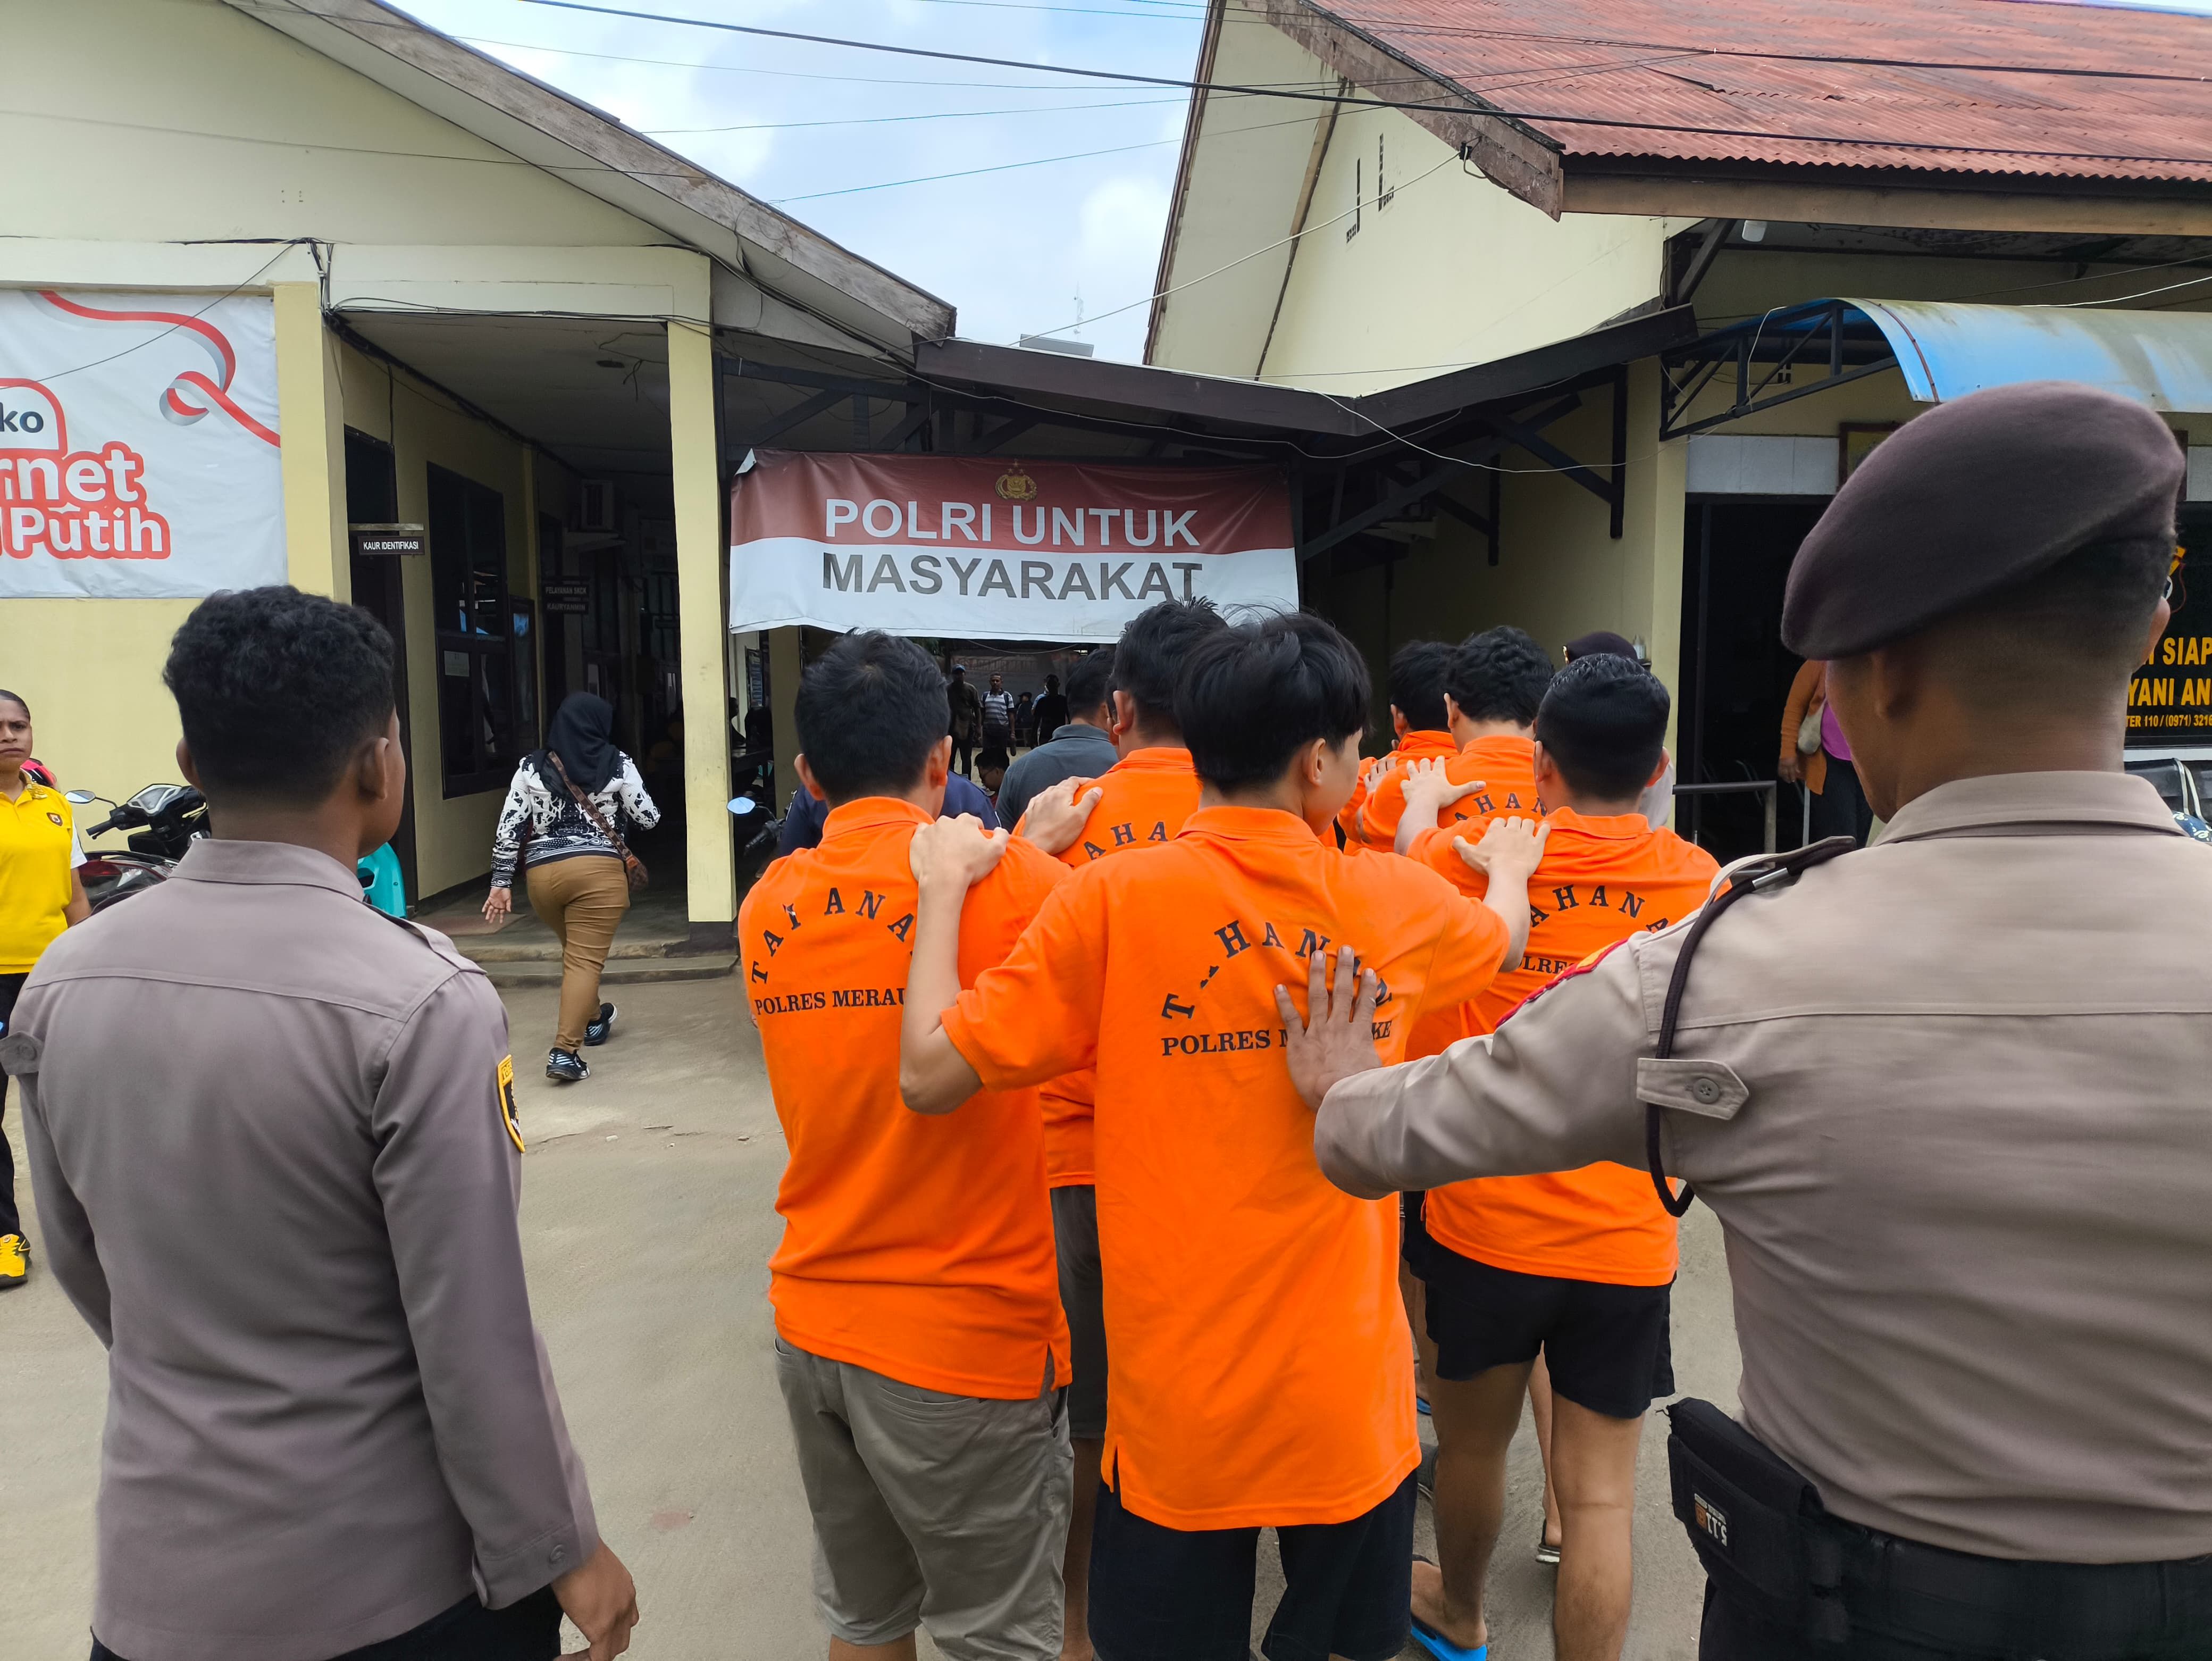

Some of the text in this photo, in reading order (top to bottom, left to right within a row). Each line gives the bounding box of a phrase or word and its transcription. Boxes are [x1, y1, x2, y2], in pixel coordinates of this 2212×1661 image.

[11, 507, 162, 552] Putih
[825, 499, 1200, 547] POLRI UNTUK
[363, 541, 419, 550] KAUR IDENTIFIKASI
[823, 552, 1203, 602] MASYARAKAT
[2163, 637, 2212, 665] SIAP
[756, 991, 826, 1015] POLRES
[1161, 1029, 1270, 1056] POLRES
